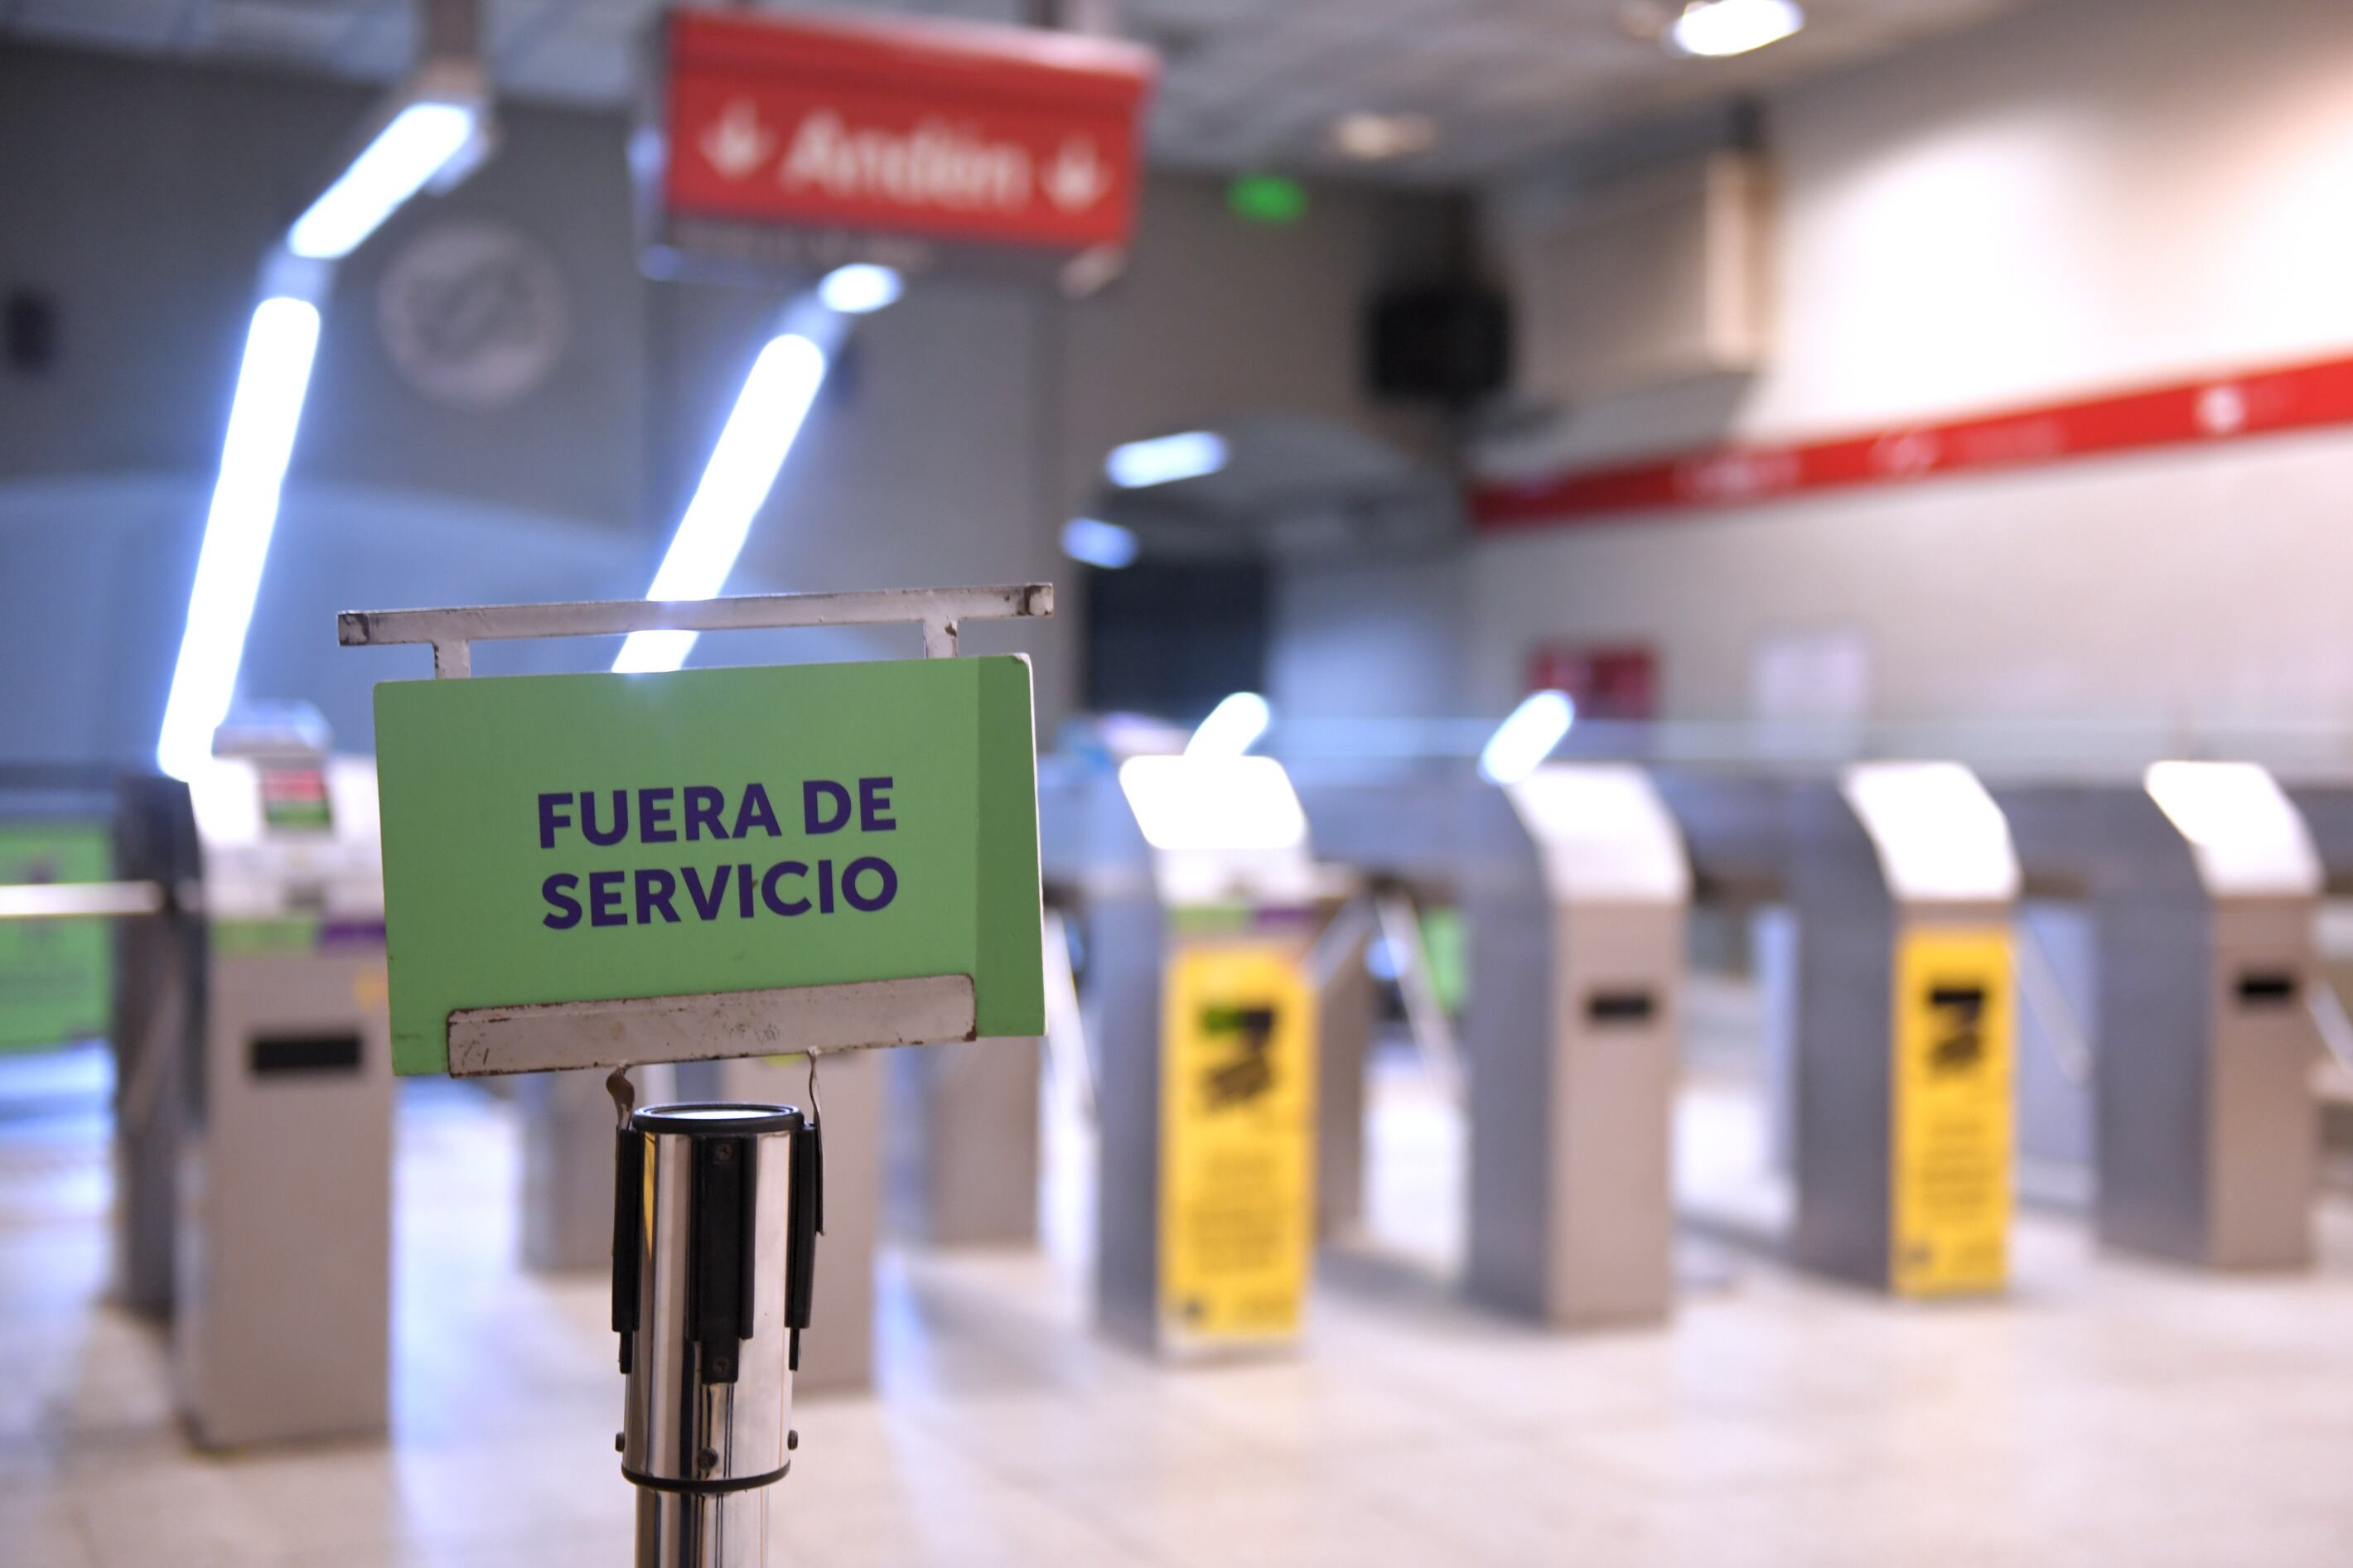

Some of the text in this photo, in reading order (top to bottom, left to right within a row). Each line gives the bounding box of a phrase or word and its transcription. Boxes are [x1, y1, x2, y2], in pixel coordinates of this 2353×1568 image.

[539, 777, 896, 849] FUERA DE
[542, 856, 898, 929] SERVICIO
